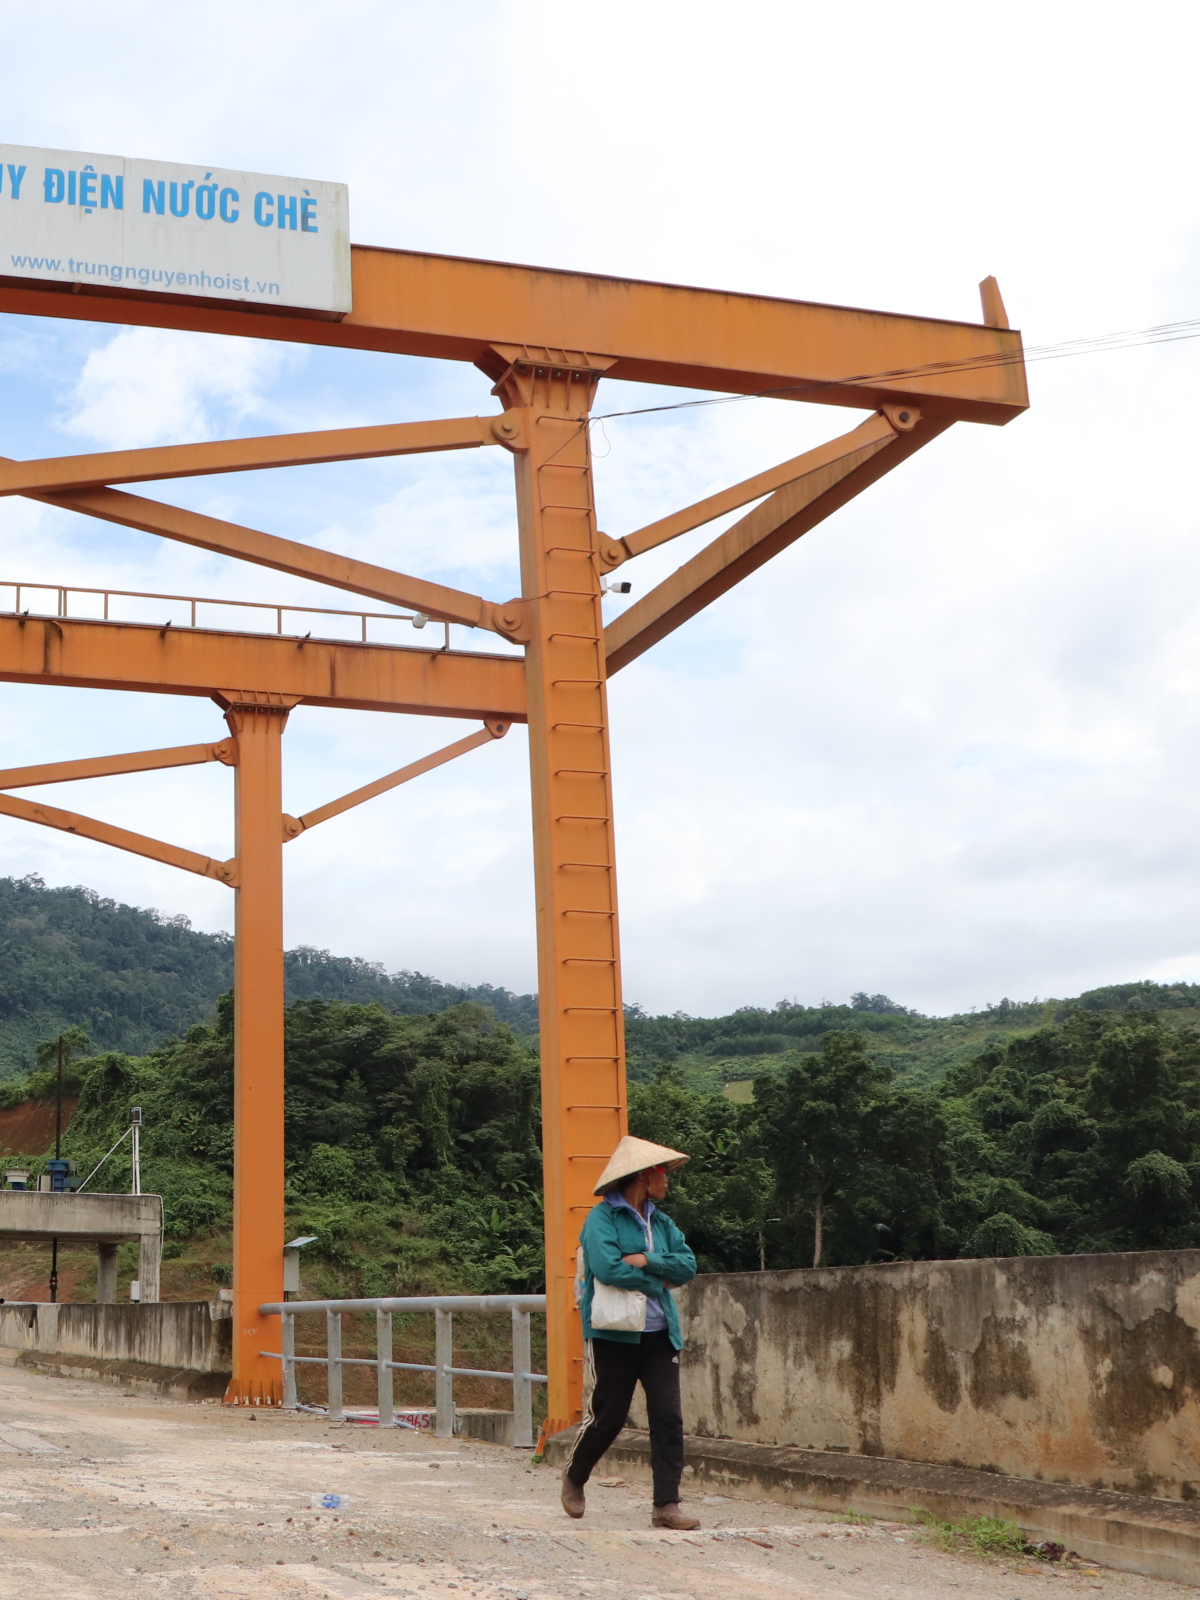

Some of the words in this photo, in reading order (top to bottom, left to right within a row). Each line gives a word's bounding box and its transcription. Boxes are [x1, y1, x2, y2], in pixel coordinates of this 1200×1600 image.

[43, 165, 125, 214] ĐIỆN
[142, 172, 240, 224] NƯỚC
[254, 190, 320, 234] CHÈ
[11, 255, 281, 294] www.trungnguyenhoist.vn
